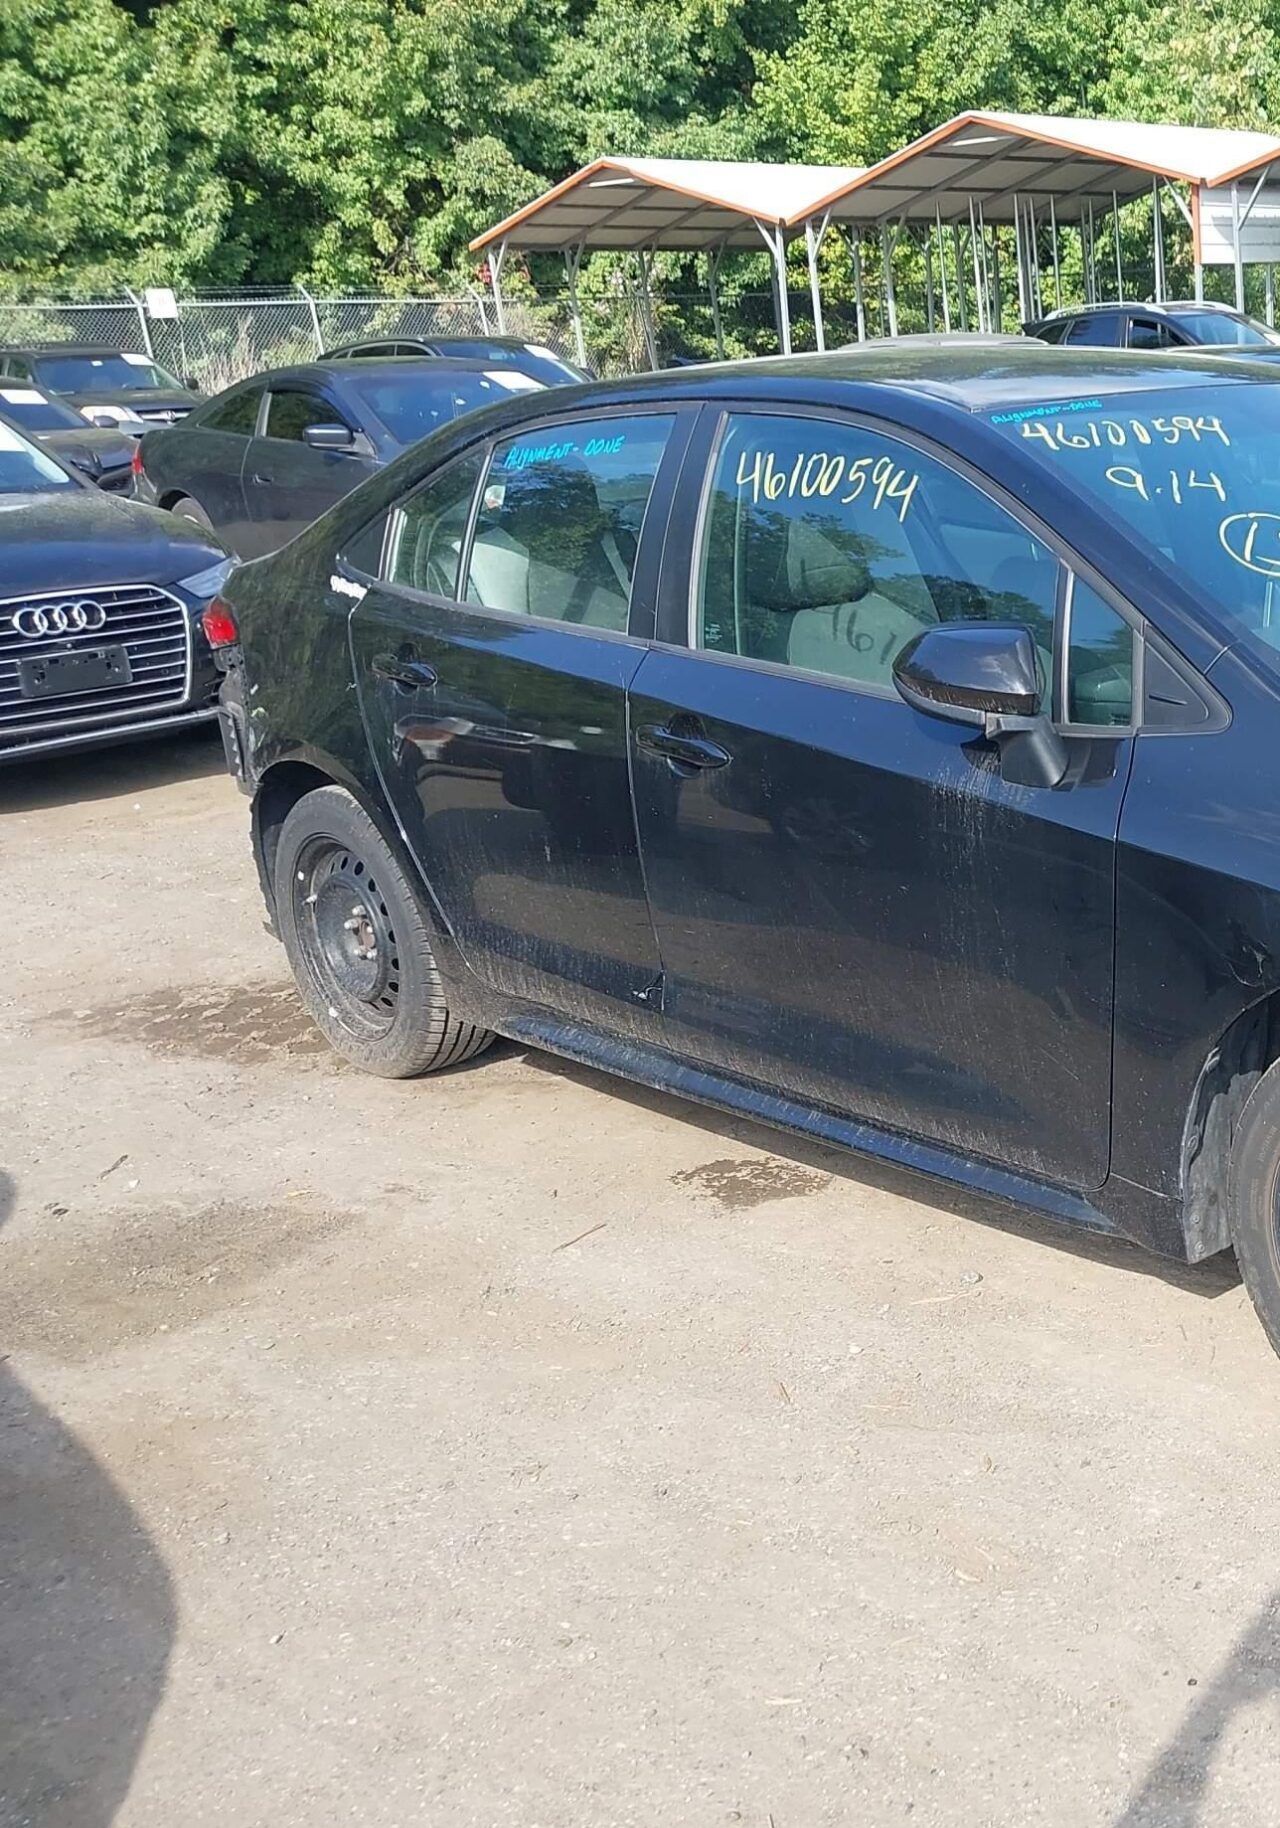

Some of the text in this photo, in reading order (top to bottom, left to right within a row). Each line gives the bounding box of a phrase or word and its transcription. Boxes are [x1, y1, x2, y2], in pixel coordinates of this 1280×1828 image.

[1022, 415, 1231, 450] 46100594
[735, 451, 919, 523] 46100594
[1105, 466, 1227, 504] 9.14
